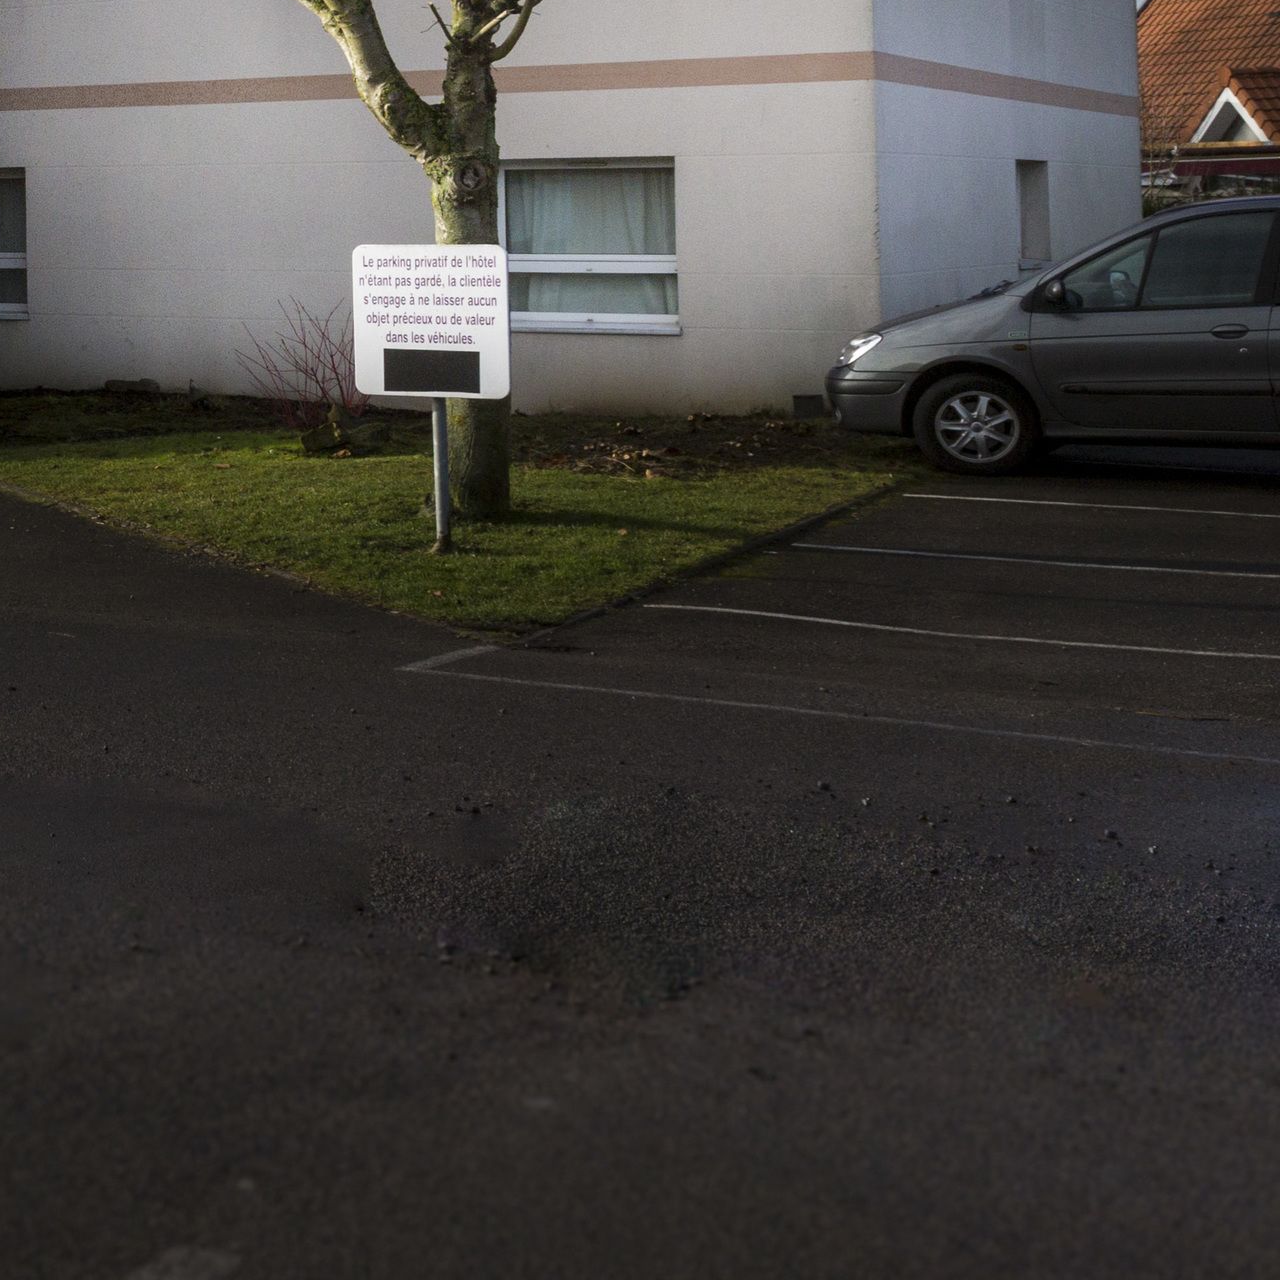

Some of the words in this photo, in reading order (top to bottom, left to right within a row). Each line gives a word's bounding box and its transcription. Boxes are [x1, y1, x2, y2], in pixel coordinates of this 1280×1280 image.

[363, 256, 374, 268] Le
[377, 256, 411, 270] parking
[415, 256, 448, 270] privatif
[451, 256, 462, 268] de
[466, 256, 496, 268] l'hôtel
[359, 275, 391, 286] n'étant
[395, 277, 411, 288] pas
[415, 275, 445, 289] gardé,
[448, 275, 456, 287] la
[460, 275, 501, 287] clientèle
[364, 294, 406, 308] s'engage
[410, 294, 414, 305] à
[418, 296, 429, 305] ne
[433, 294, 464, 306] laisser
[468, 296, 497, 306] aucun
[367, 313, 389, 327] objet
[393, 313, 432, 326] précieux
[436, 315, 447, 324] ou
[451, 313, 462, 325] de
[465, 314, 495, 326] valeur
[386, 331, 408, 343] dans
[412, 332, 424, 343] les
[428, 332, 475, 344] véhicules.
